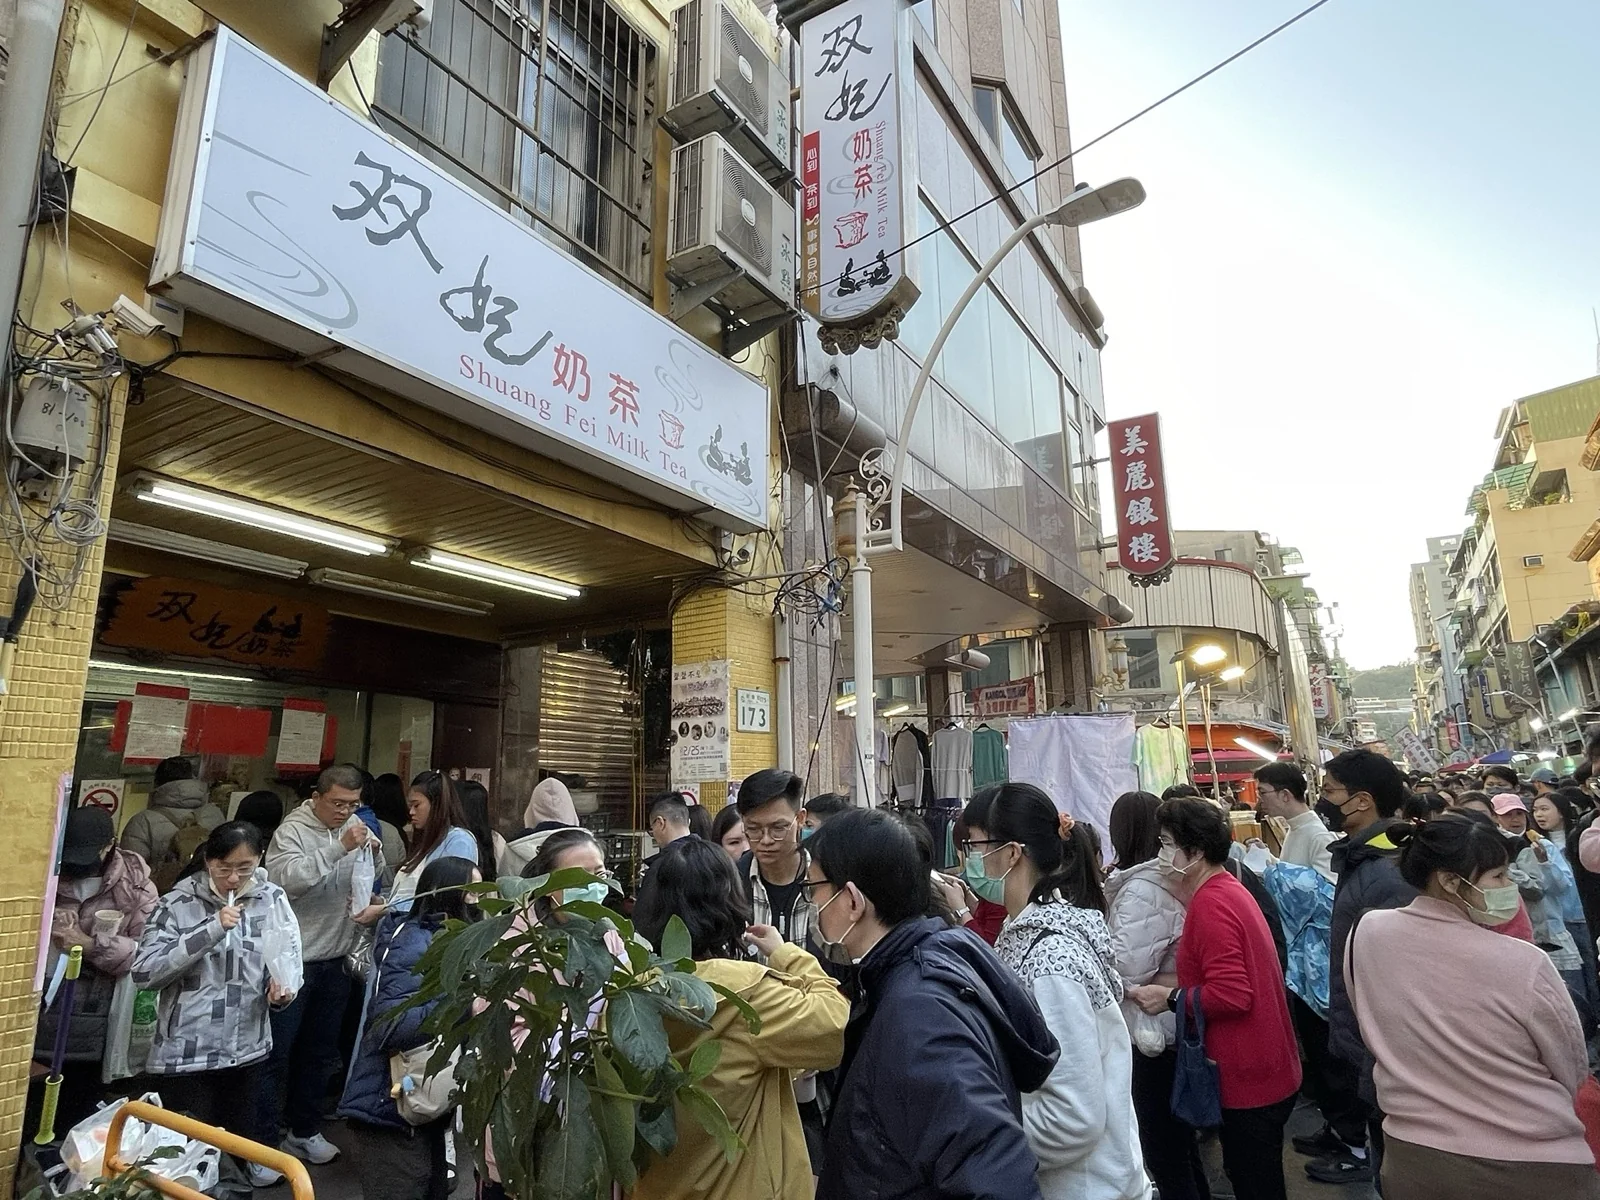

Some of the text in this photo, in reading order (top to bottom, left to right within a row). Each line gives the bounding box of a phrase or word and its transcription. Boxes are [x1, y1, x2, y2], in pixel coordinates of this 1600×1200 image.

[874, 120, 888, 238] Shuang Fei Milk Tea
[459, 354, 687, 480] Shuang Fei Milk Tea
[1120, 425, 1160, 562] 美麗銀樓
[742, 706, 766, 727] 173
